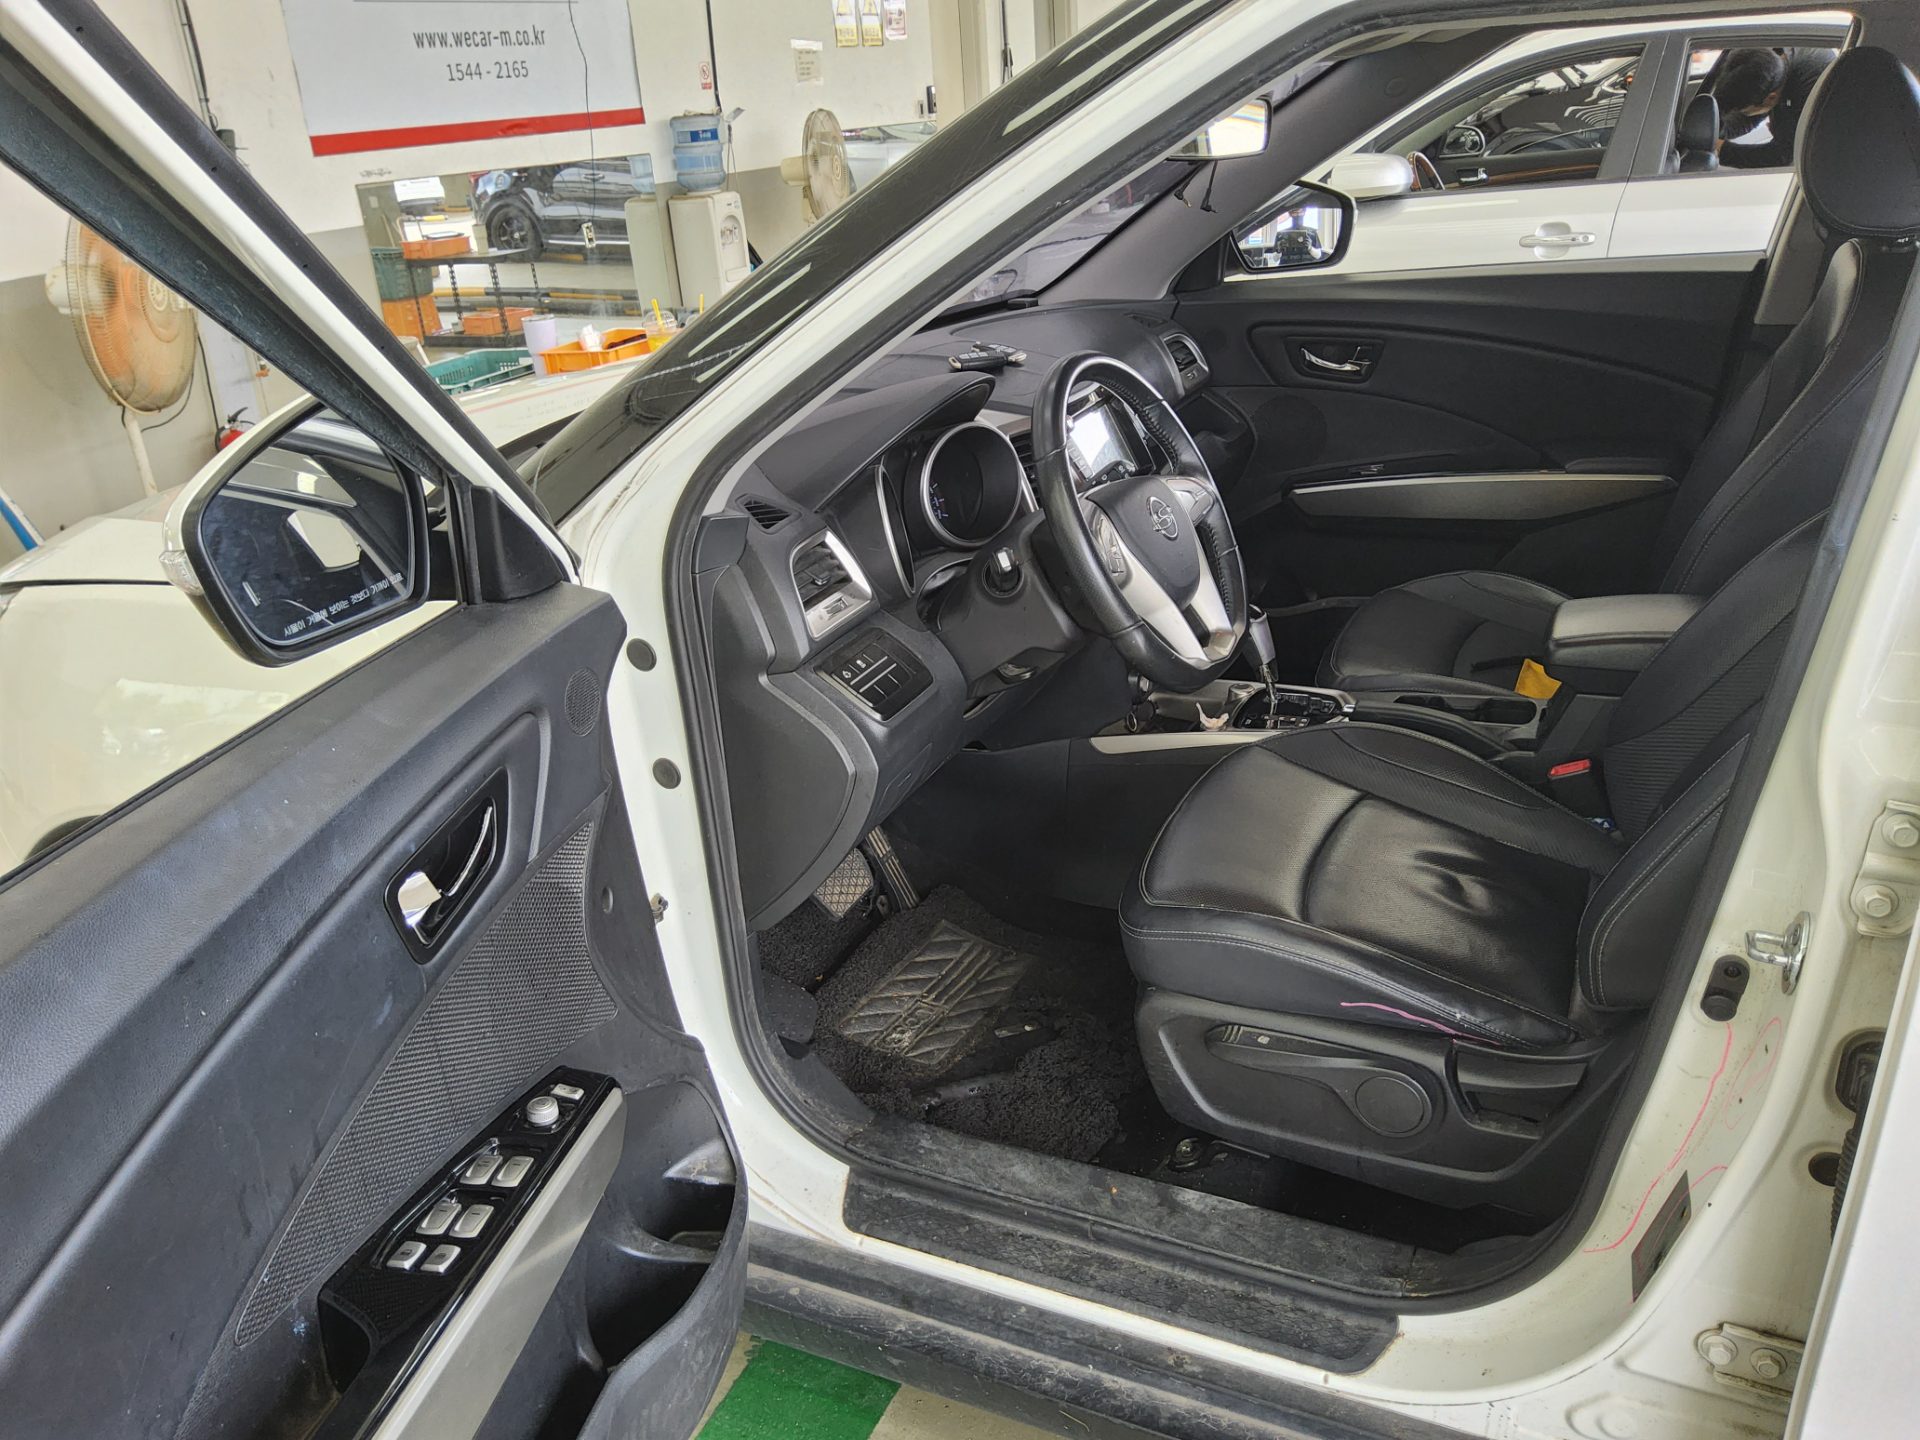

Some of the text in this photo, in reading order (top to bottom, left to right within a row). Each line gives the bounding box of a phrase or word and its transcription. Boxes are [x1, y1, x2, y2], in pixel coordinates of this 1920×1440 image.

[412, 24, 546, 49] www.wecar-m.co.kr
[283, 620, 305, 637] 사물이
[329, 600, 350, 615] 보이는
[350, 590, 370, 604] 것보다
